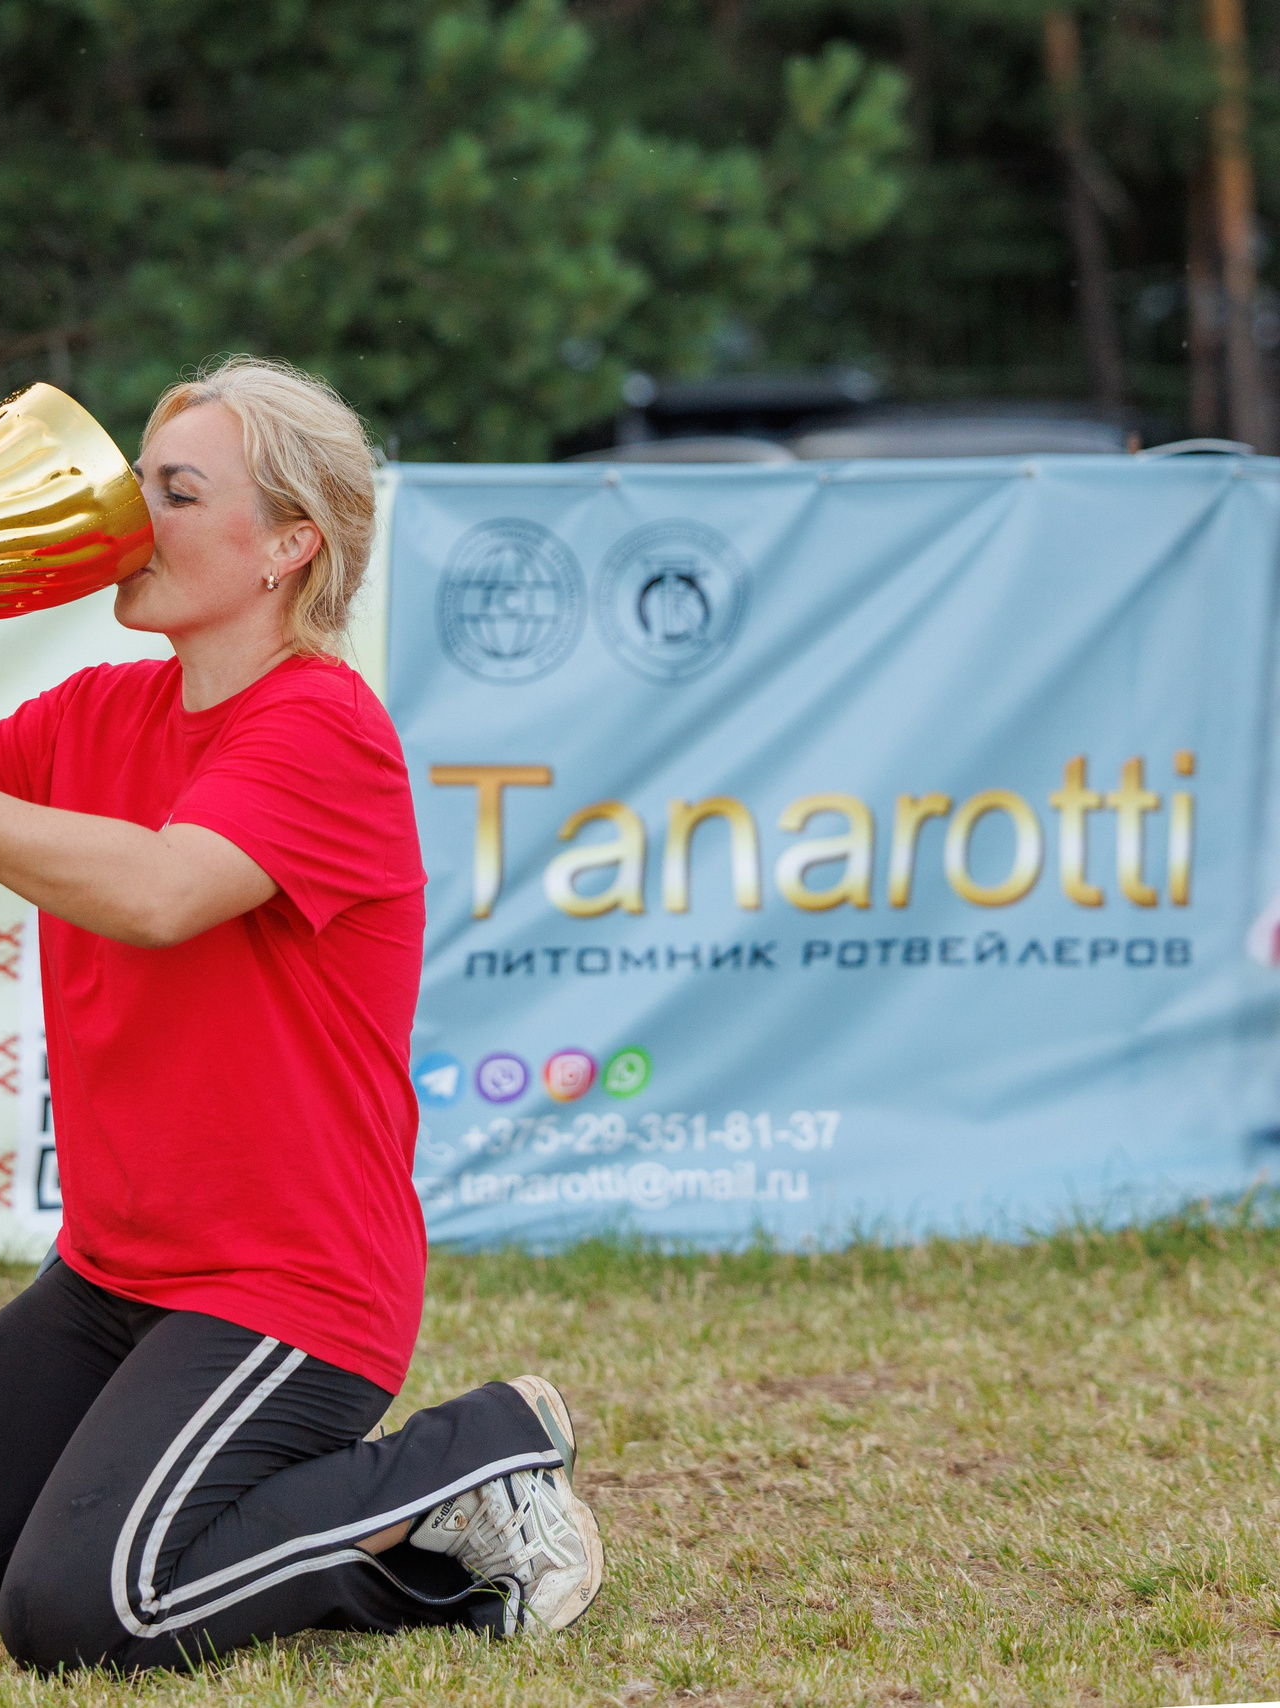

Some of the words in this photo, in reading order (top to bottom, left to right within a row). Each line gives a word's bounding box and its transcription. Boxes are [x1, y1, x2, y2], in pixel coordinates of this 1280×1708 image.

[429, 750, 1199, 920] Tanarotti
[465, 939, 777, 978] ПИТОМНИК
[802, 931, 1194, 970] РОТВЕЙЛЕРОВ
[462, 1110, 841, 1155] +375-29-351-81-37
[460, 1160, 809, 1209] tanarotti@mail.ru
